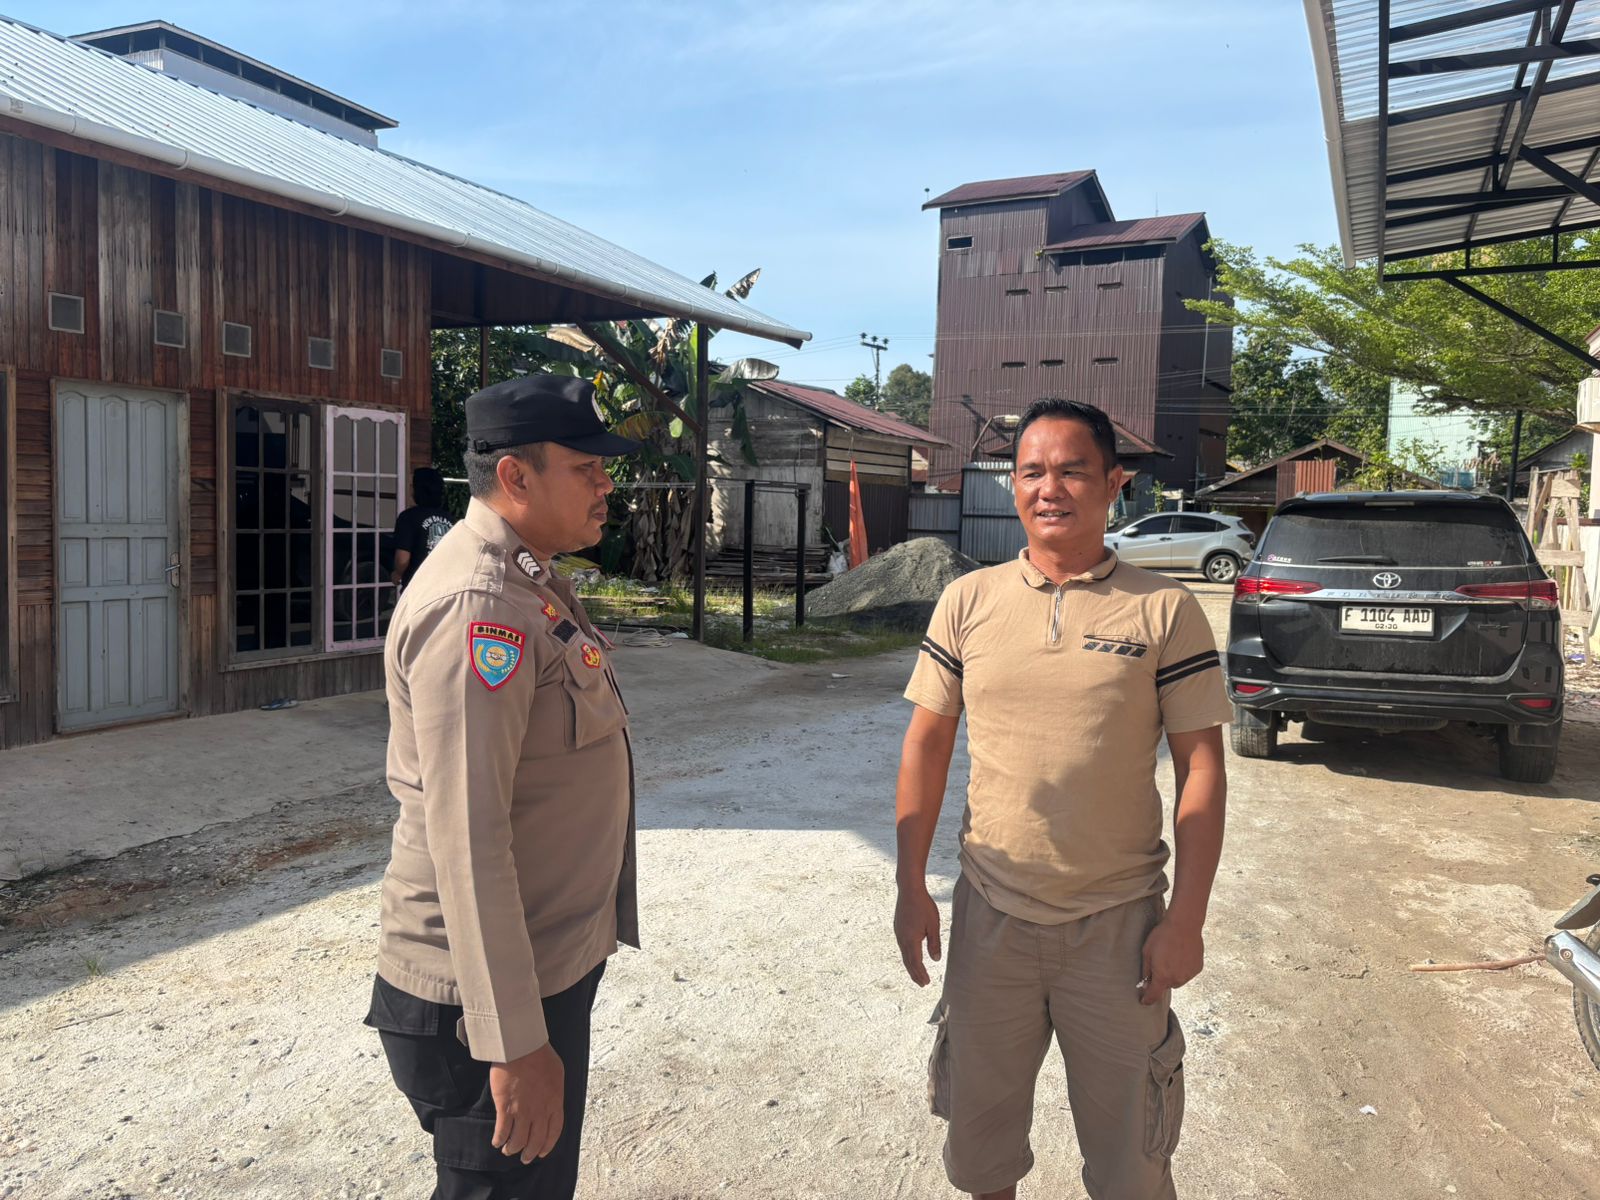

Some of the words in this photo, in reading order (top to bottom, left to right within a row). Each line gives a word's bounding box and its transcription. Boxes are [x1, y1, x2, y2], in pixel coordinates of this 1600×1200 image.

[422, 516, 433, 530] NEW
[1345, 607, 1353, 621] F
[1360, 608, 1395, 622] 1104
[1403, 608, 1430, 623] AAD
[477, 626, 520, 642] BINMAS
